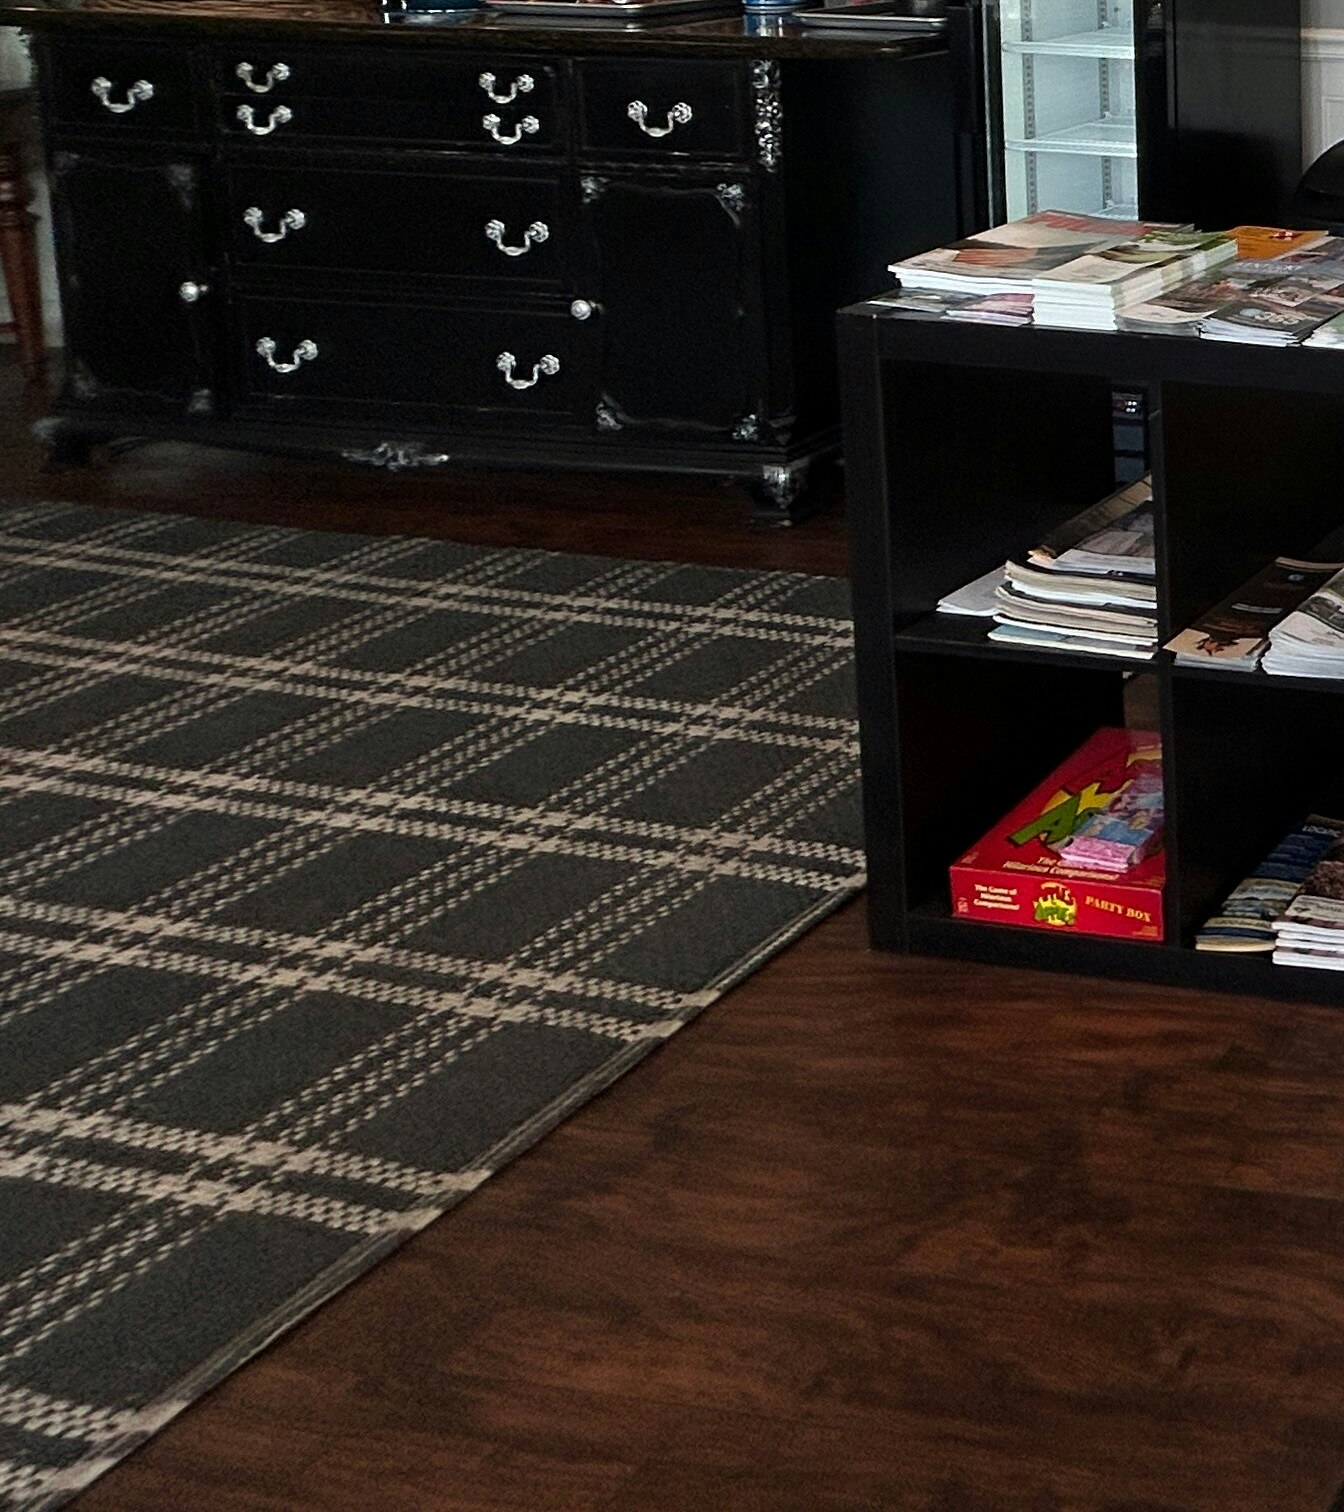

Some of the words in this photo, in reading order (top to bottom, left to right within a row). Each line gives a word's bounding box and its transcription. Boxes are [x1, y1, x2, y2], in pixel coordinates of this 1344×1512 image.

[988, 885, 1008, 894] Game
[1085, 895, 1125, 914] PARTY
[1126, 906, 1152, 923] BOX
